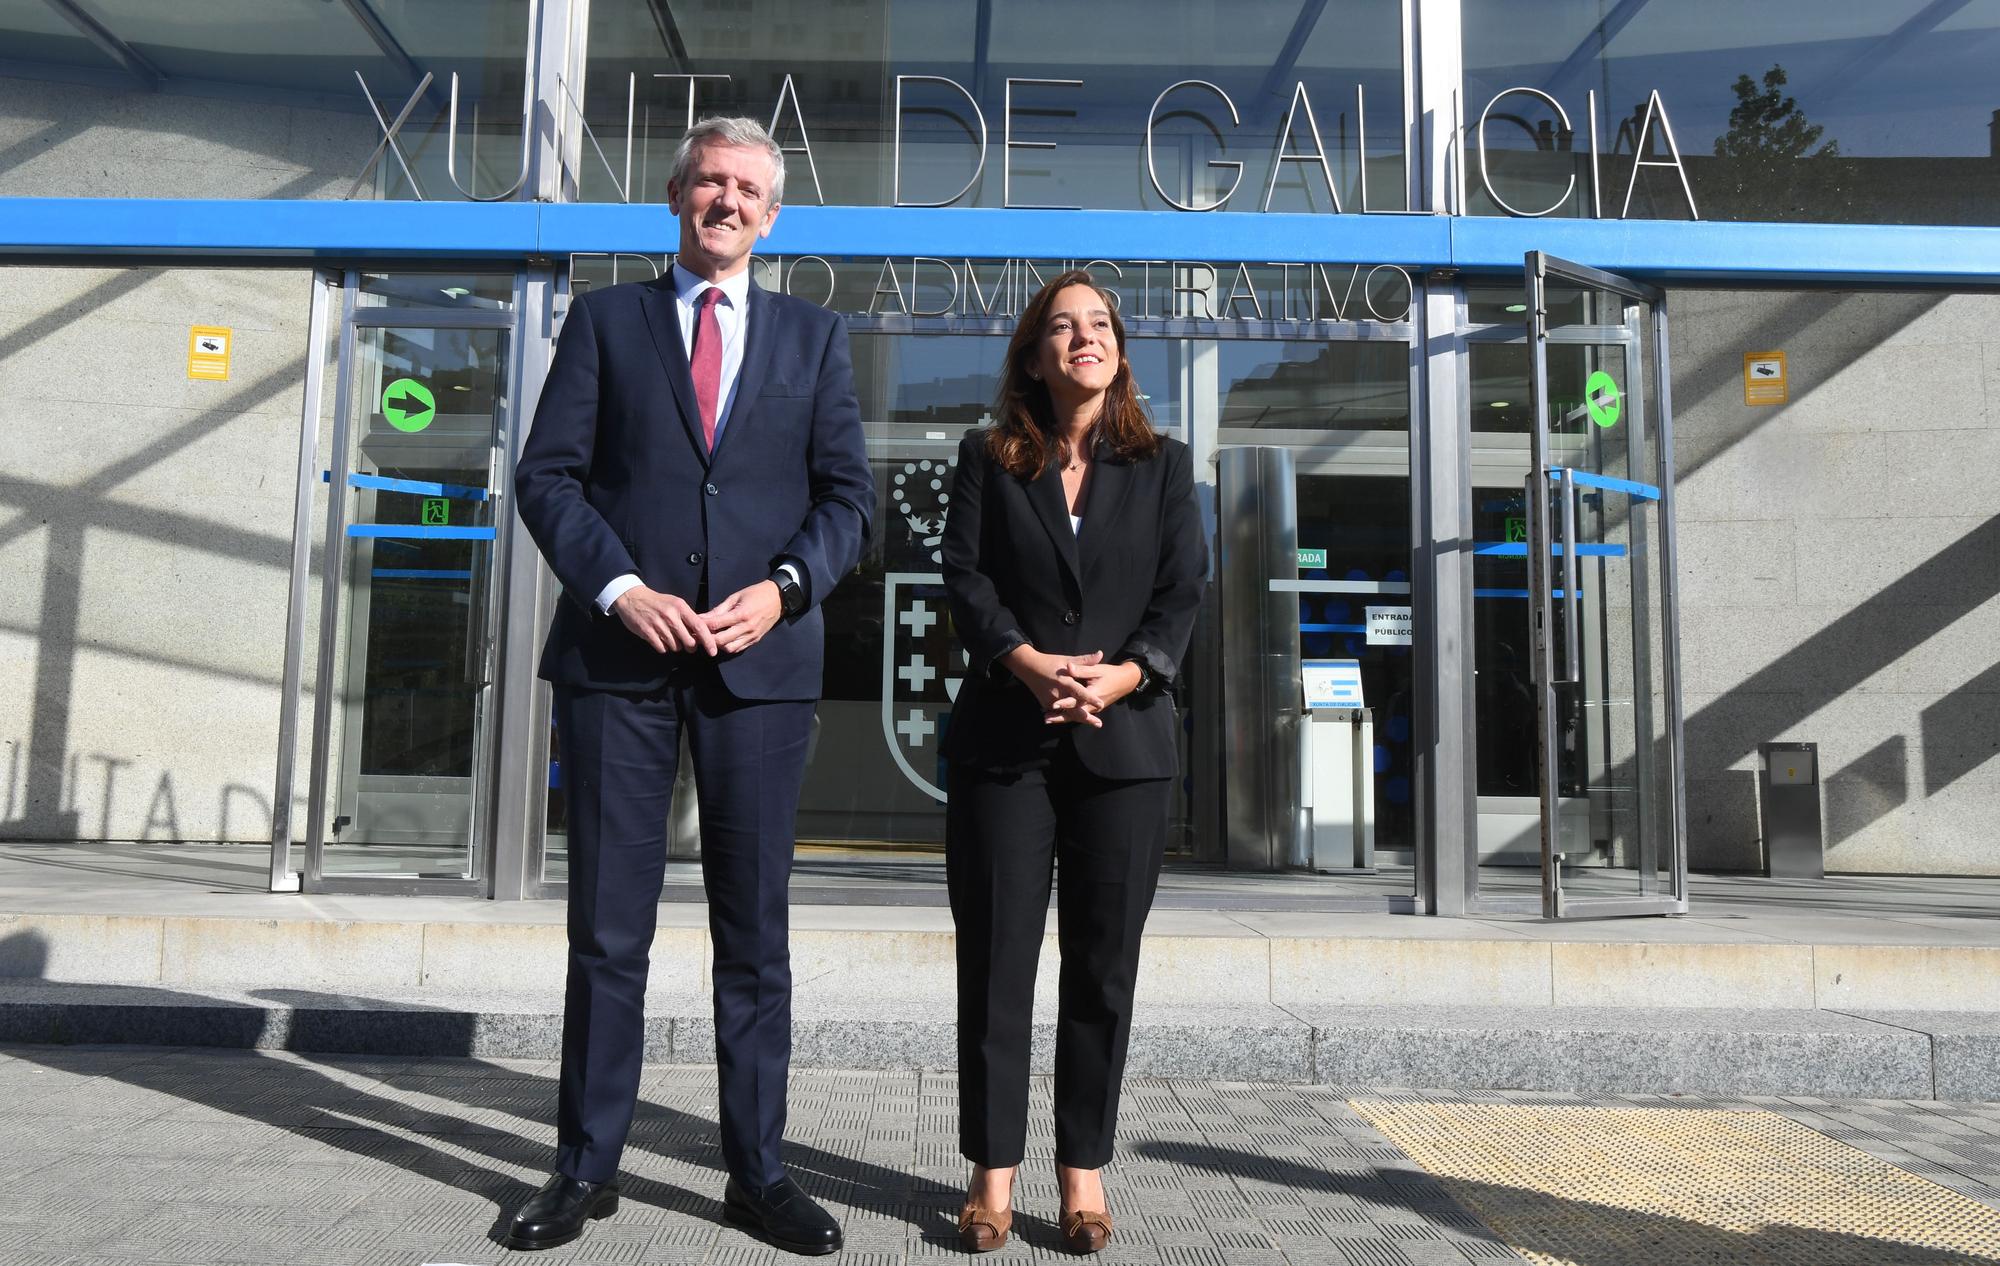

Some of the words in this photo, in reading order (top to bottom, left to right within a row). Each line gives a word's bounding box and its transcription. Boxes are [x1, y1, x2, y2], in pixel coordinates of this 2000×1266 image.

[345, 70, 824, 206] XUNTA
[894, 74, 1084, 210] DE
[1146, 79, 1699, 219] GALICIA
[867, 256, 1413, 323] ADMINSTRATIVO
[1297, 553, 1322, 563] RADA
[1375, 627, 1413, 636] PÚBLICO
